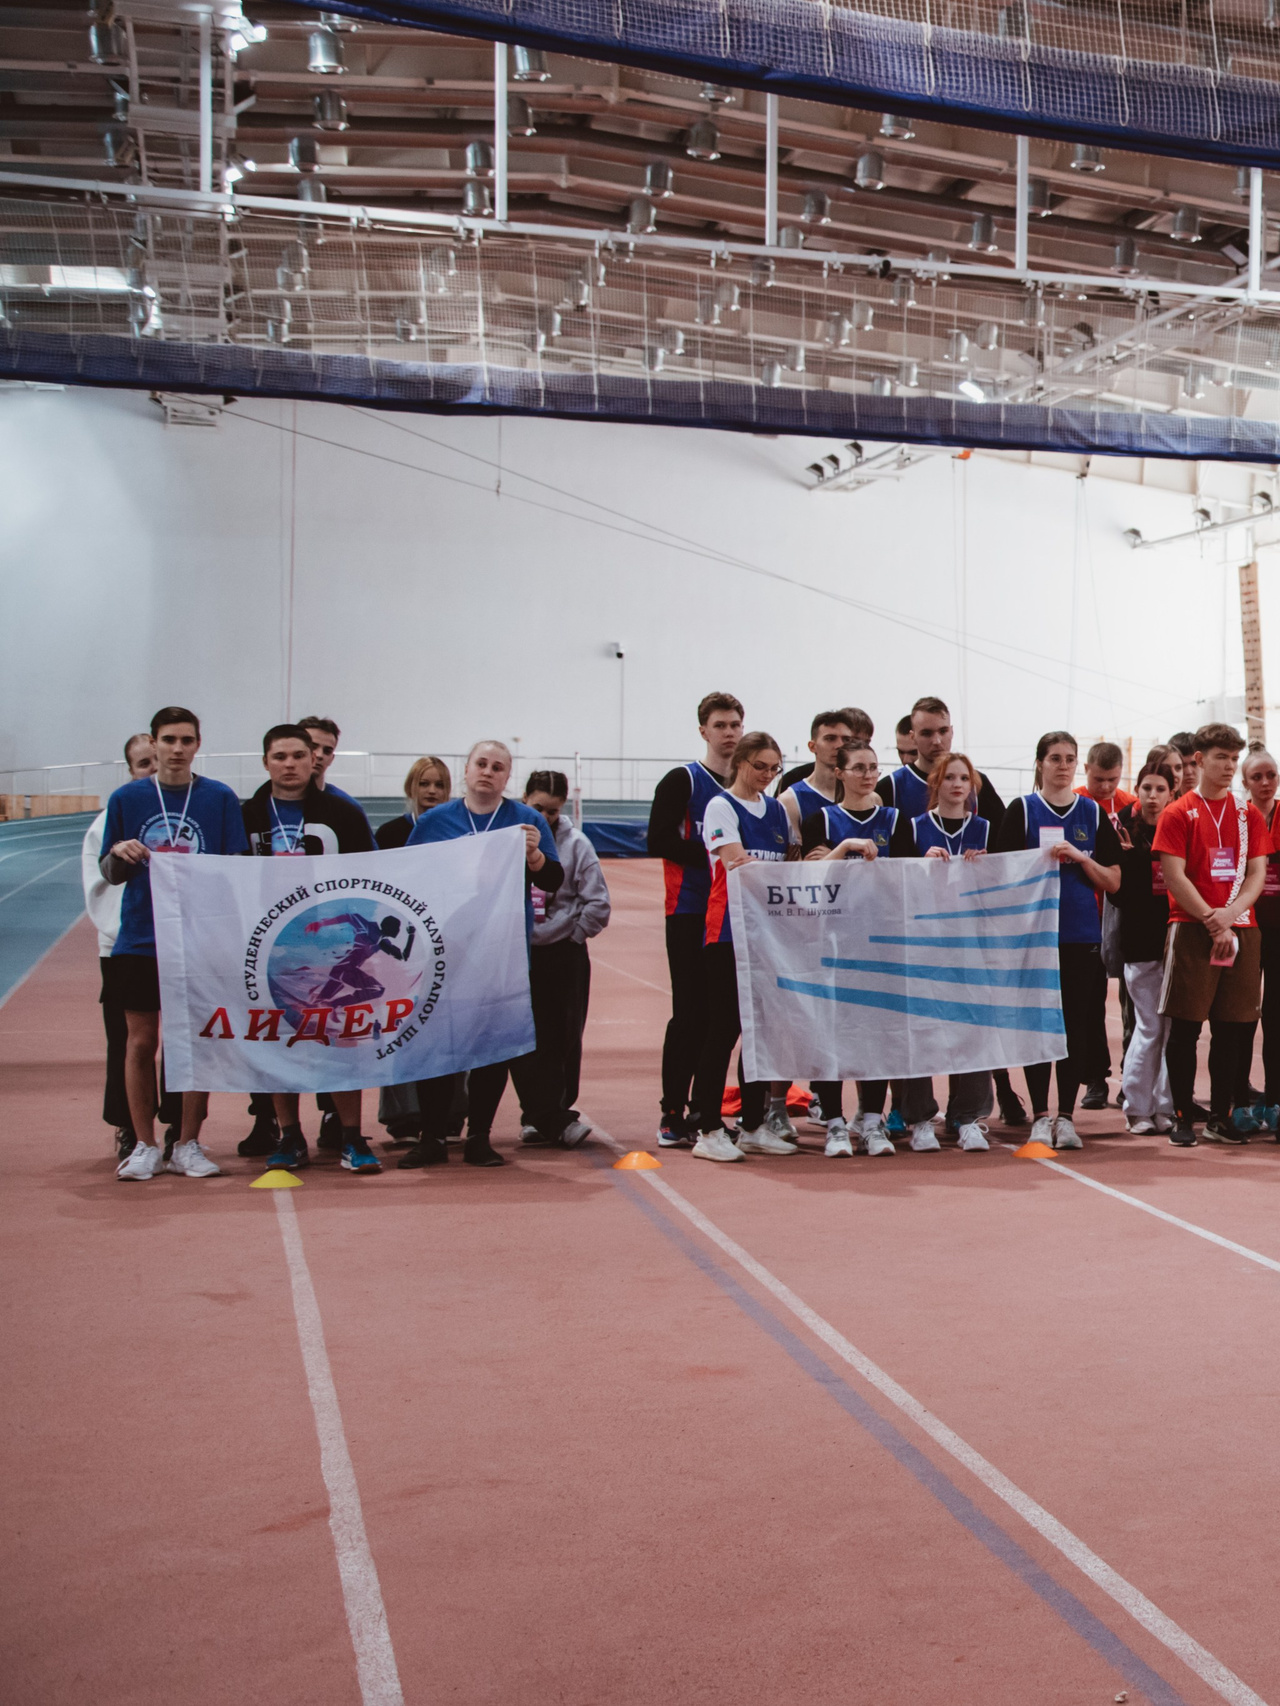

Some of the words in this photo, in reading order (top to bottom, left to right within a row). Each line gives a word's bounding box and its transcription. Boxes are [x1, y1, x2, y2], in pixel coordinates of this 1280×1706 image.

[314, 878, 429, 917] СПОРТИВНЫЙ
[767, 884, 841, 905] БГТУ
[807, 908, 842, 917] Шухова
[244, 885, 311, 1001] СТУДЕНЧЕСКИЙ
[422, 916, 446, 957] КЛУБ
[418, 960, 447, 1026] ОГАПОУ
[199, 998, 414, 1048] ЛИДЕР
[376, 1026, 419, 1061] ШАРТ
